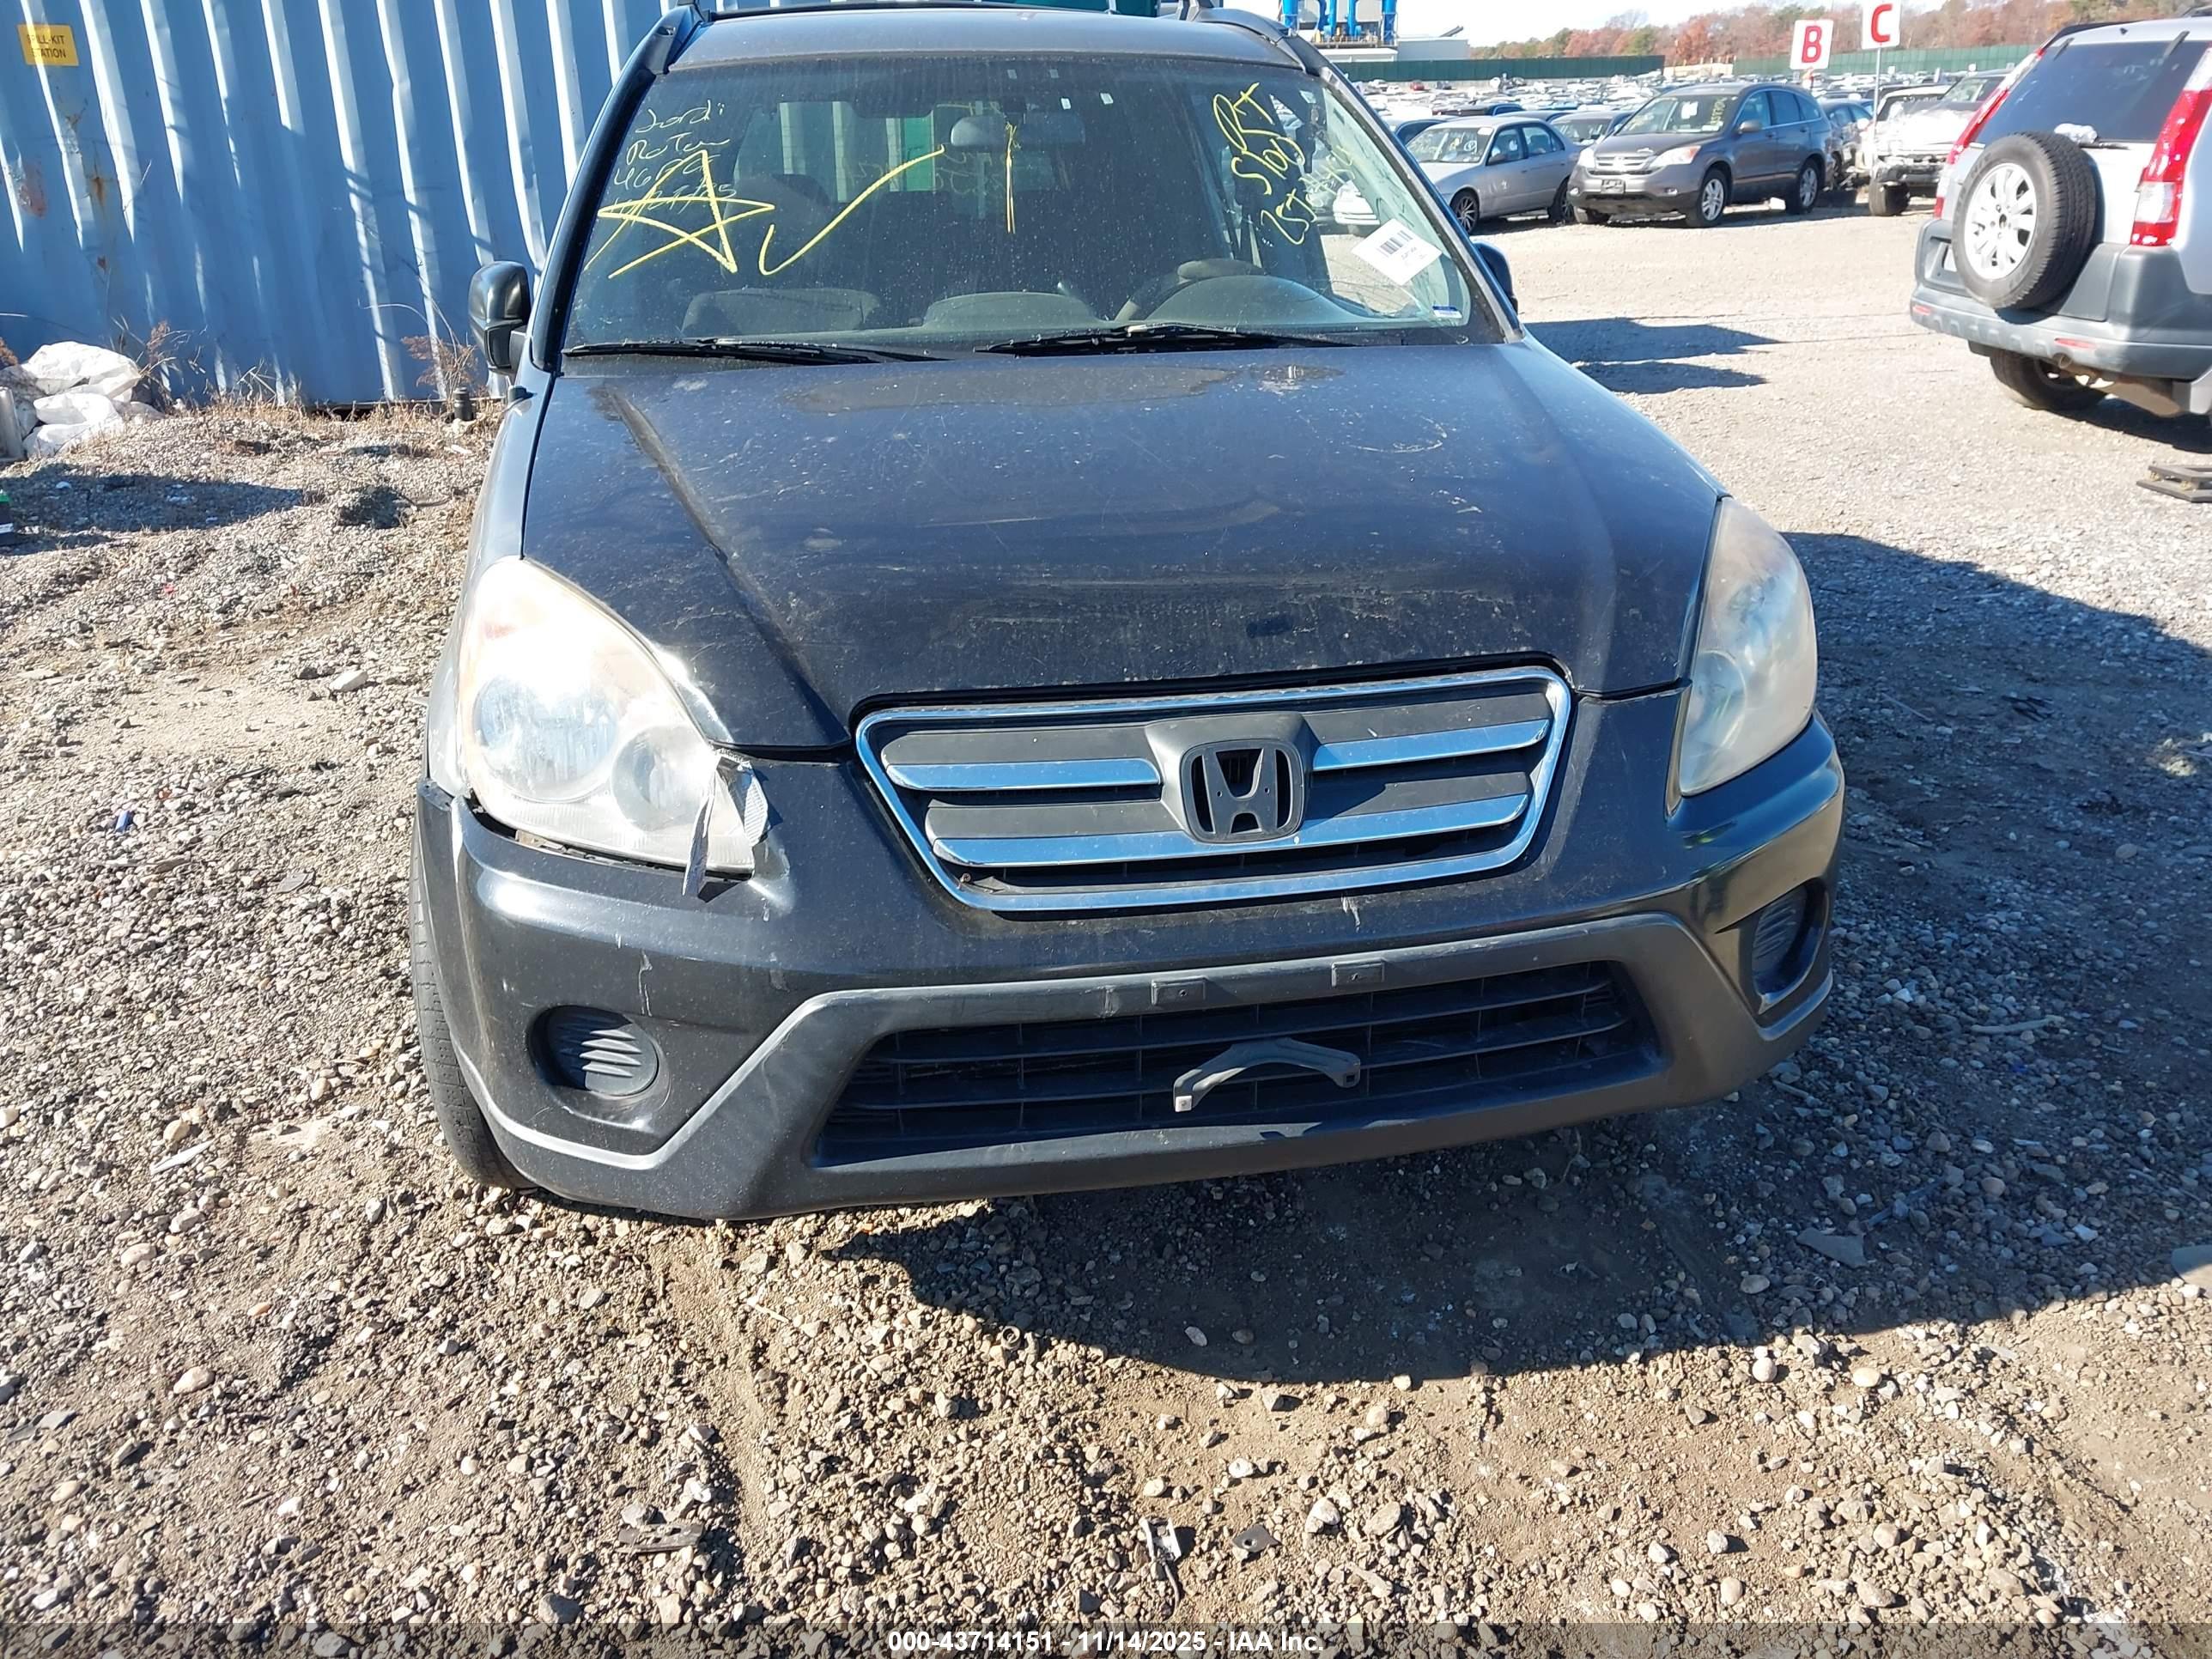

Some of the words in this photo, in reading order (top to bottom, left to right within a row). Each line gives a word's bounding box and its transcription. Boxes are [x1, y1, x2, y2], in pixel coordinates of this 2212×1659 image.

[1870, 3, 1893, 43] C
[27, 33, 65, 45] SLL-KIT
[1802, 25, 1822, 63] B
[31, 47, 67, 58] SATION
